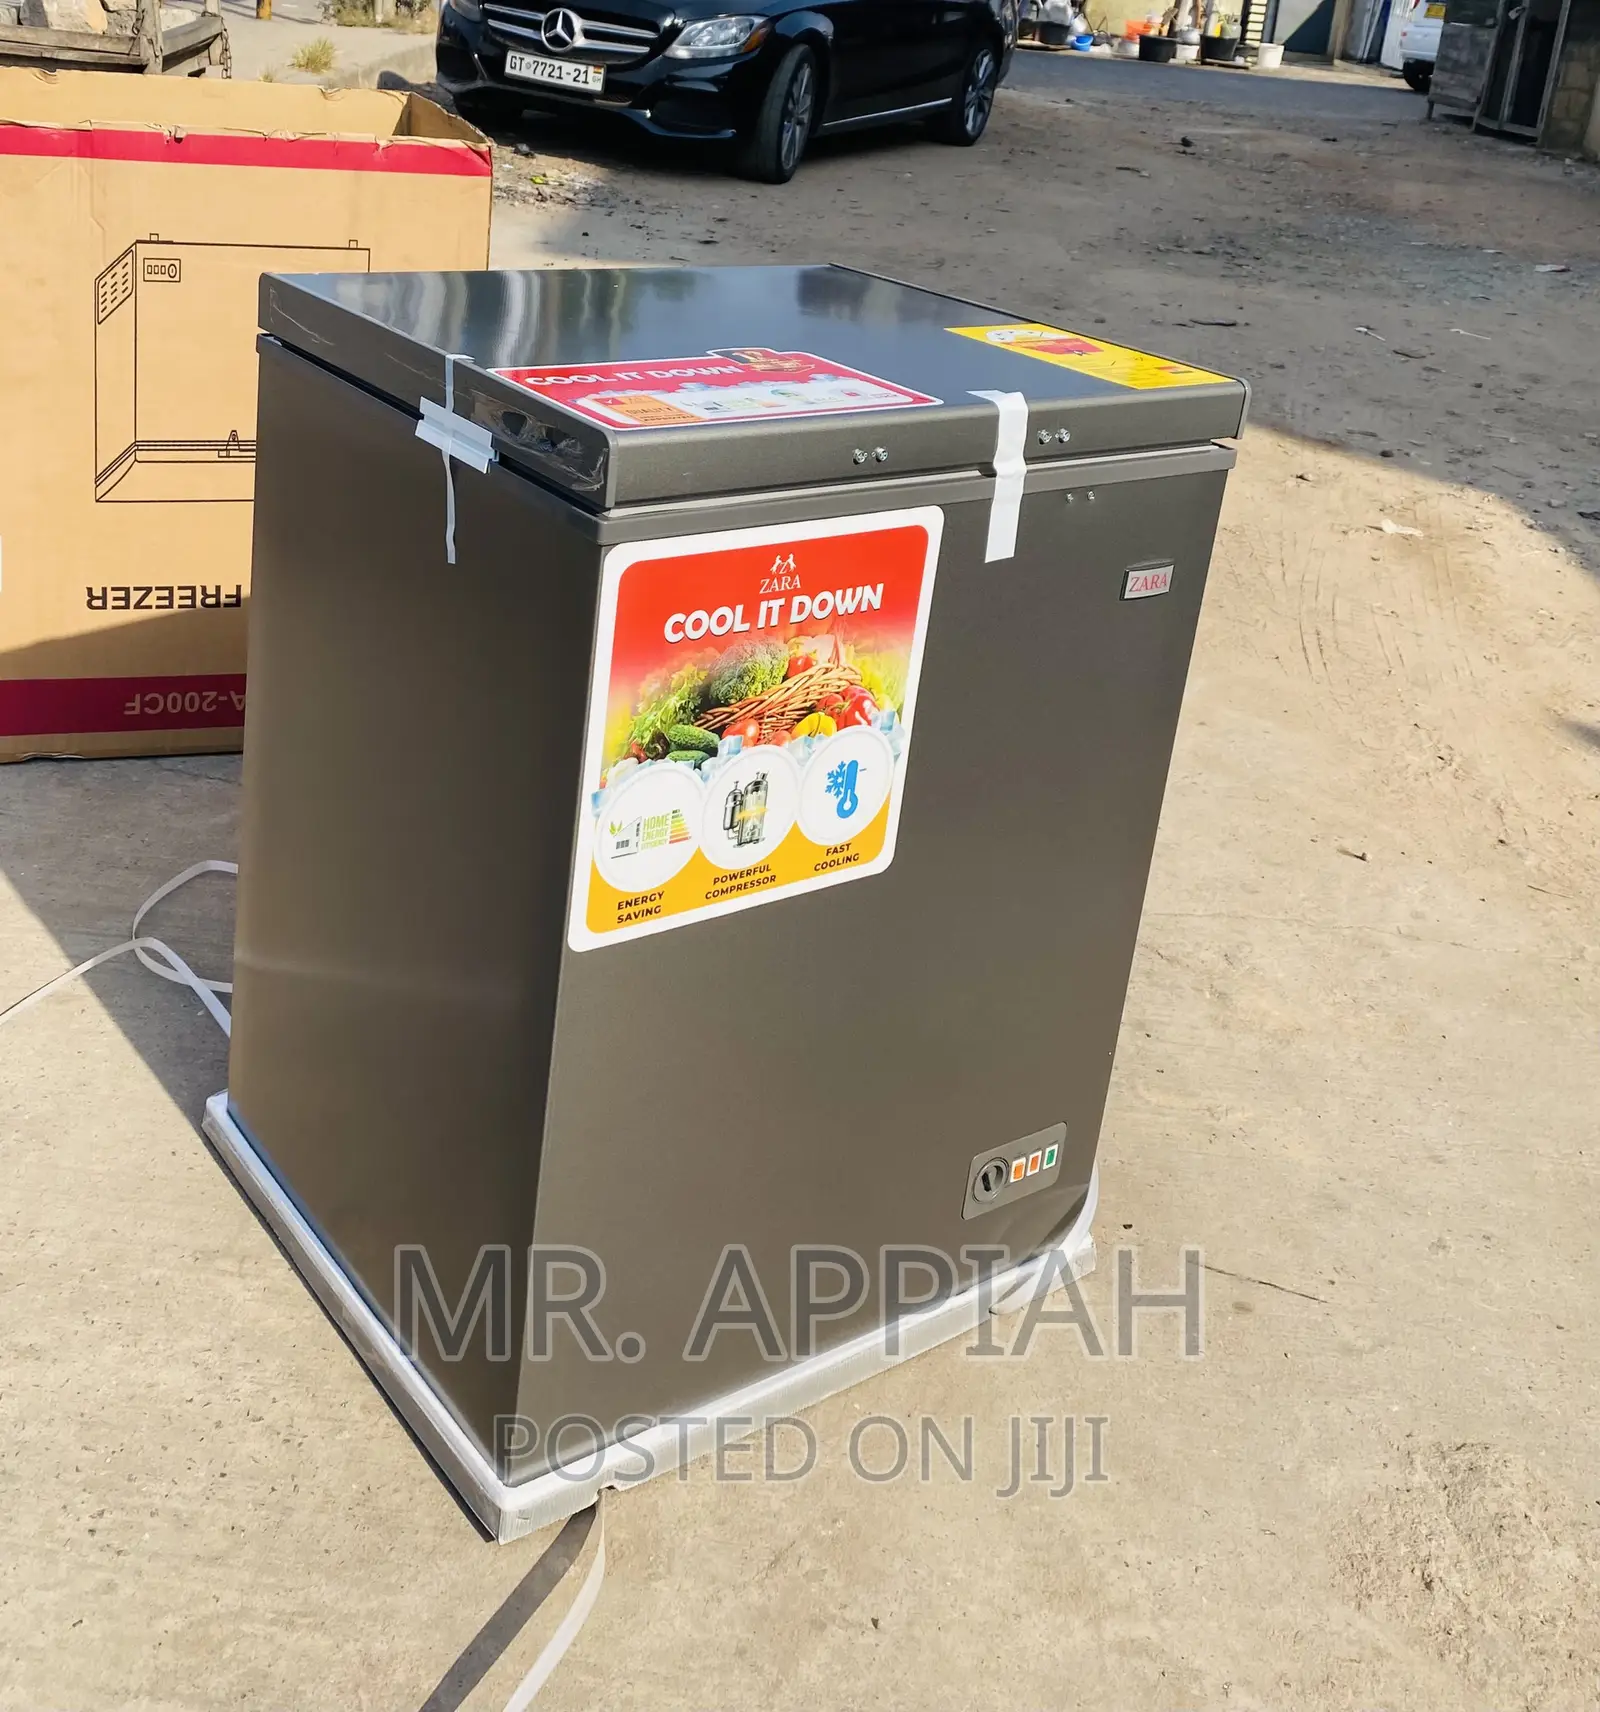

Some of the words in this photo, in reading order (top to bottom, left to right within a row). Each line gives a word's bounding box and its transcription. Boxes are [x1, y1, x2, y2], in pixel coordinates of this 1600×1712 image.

[510, 55, 525, 71] GT
[532, 60, 589, 84] 7721-21
[525, 372, 618, 386] COOL
[615, 371, 645, 382] IT
[645, 366, 745, 379] DOWN
[759, 575, 801, 594] ZARA
[1128, 572, 1168, 593] ZARA
[86, 584, 242, 610] FREEZER
[664, 604, 750, 643] COOL
[757, 598, 785, 629] IT
[789, 583, 884, 624] DOWN
[643, 813, 670, 832] HOME
[642, 828, 669, 842] ENERGY
[826, 843, 852, 856] FAST
[813, 853, 860, 872] COOLING
[713, 864, 772, 885] POWERFUL
[705, 875, 777, 900] COMPRESSOR
[617, 890, 665, 910] ENERGY
[616, 905, 662, 924] SAVING
